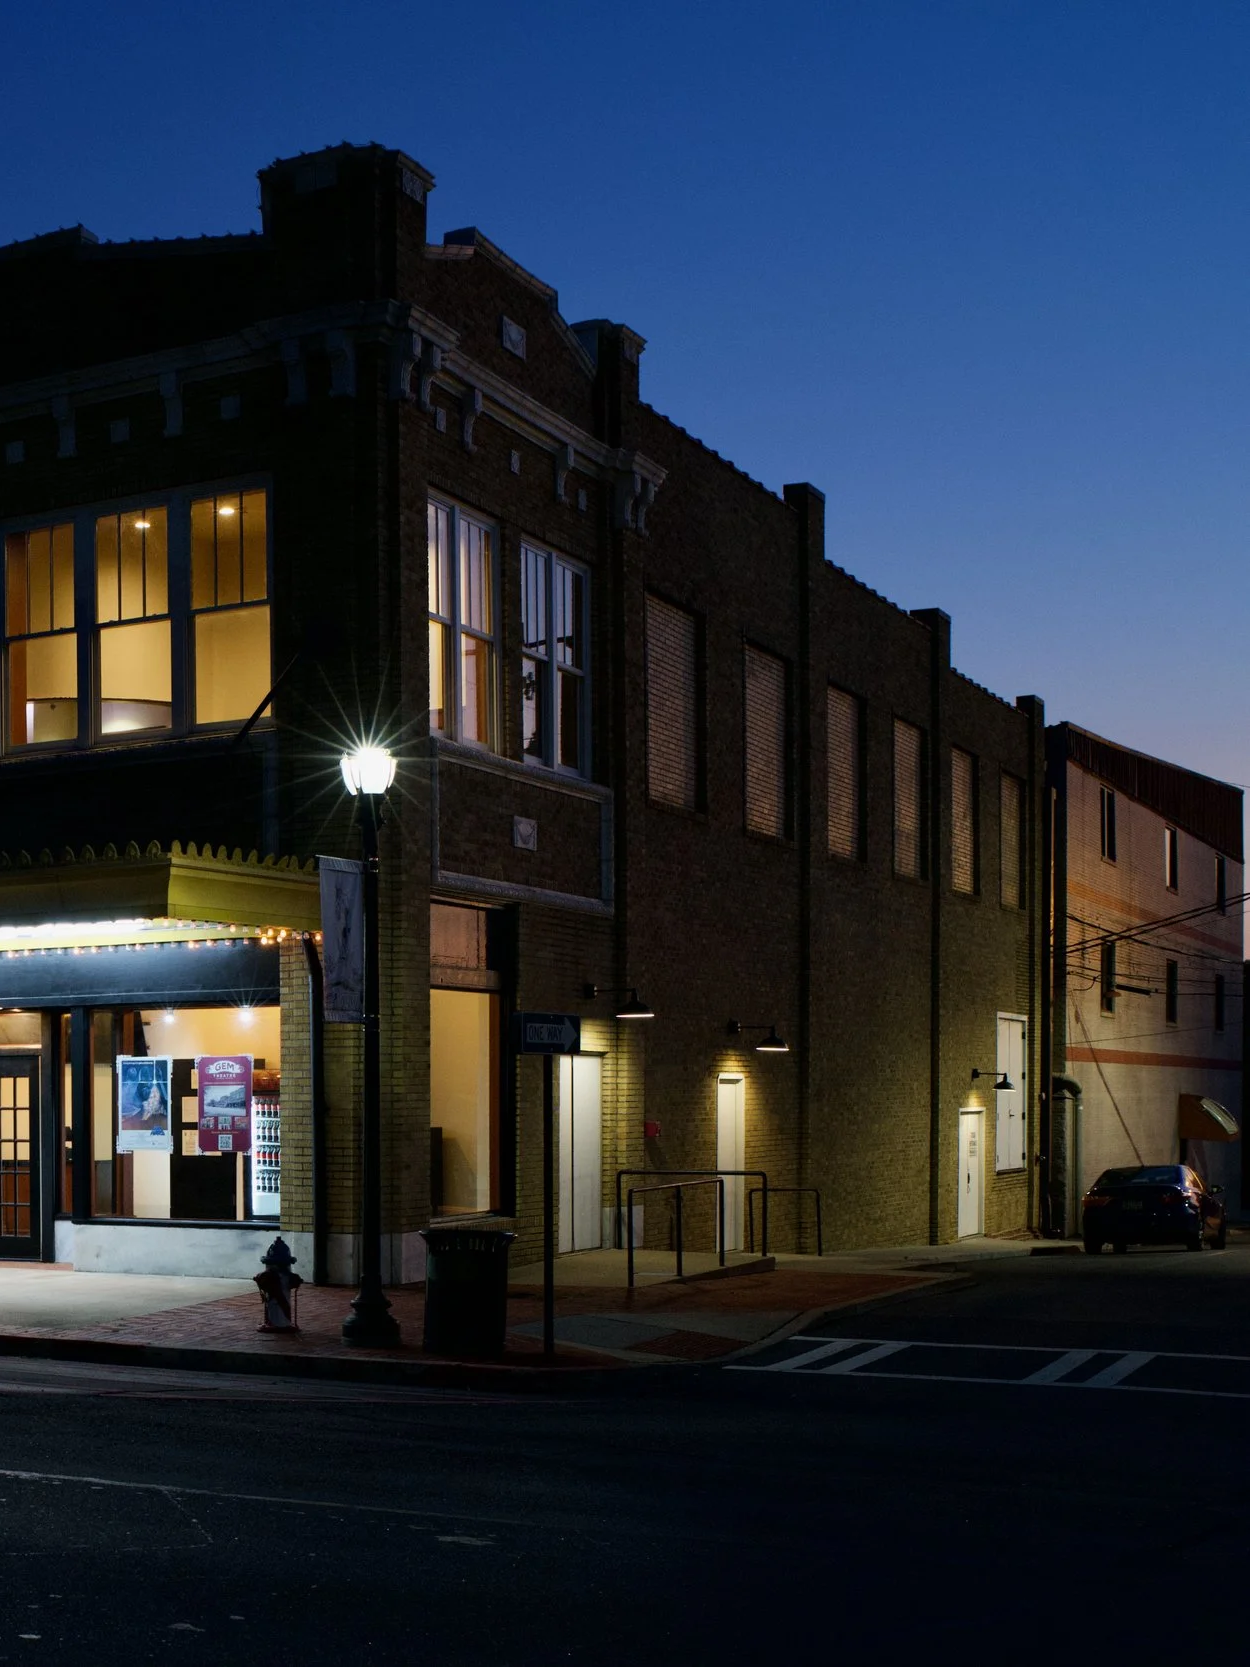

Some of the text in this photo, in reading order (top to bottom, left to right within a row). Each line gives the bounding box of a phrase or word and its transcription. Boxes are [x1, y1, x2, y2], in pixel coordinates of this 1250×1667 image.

[529, 1024, 563, 1041] ONE WAY
[215, 1062, 235, 1071] GEM
